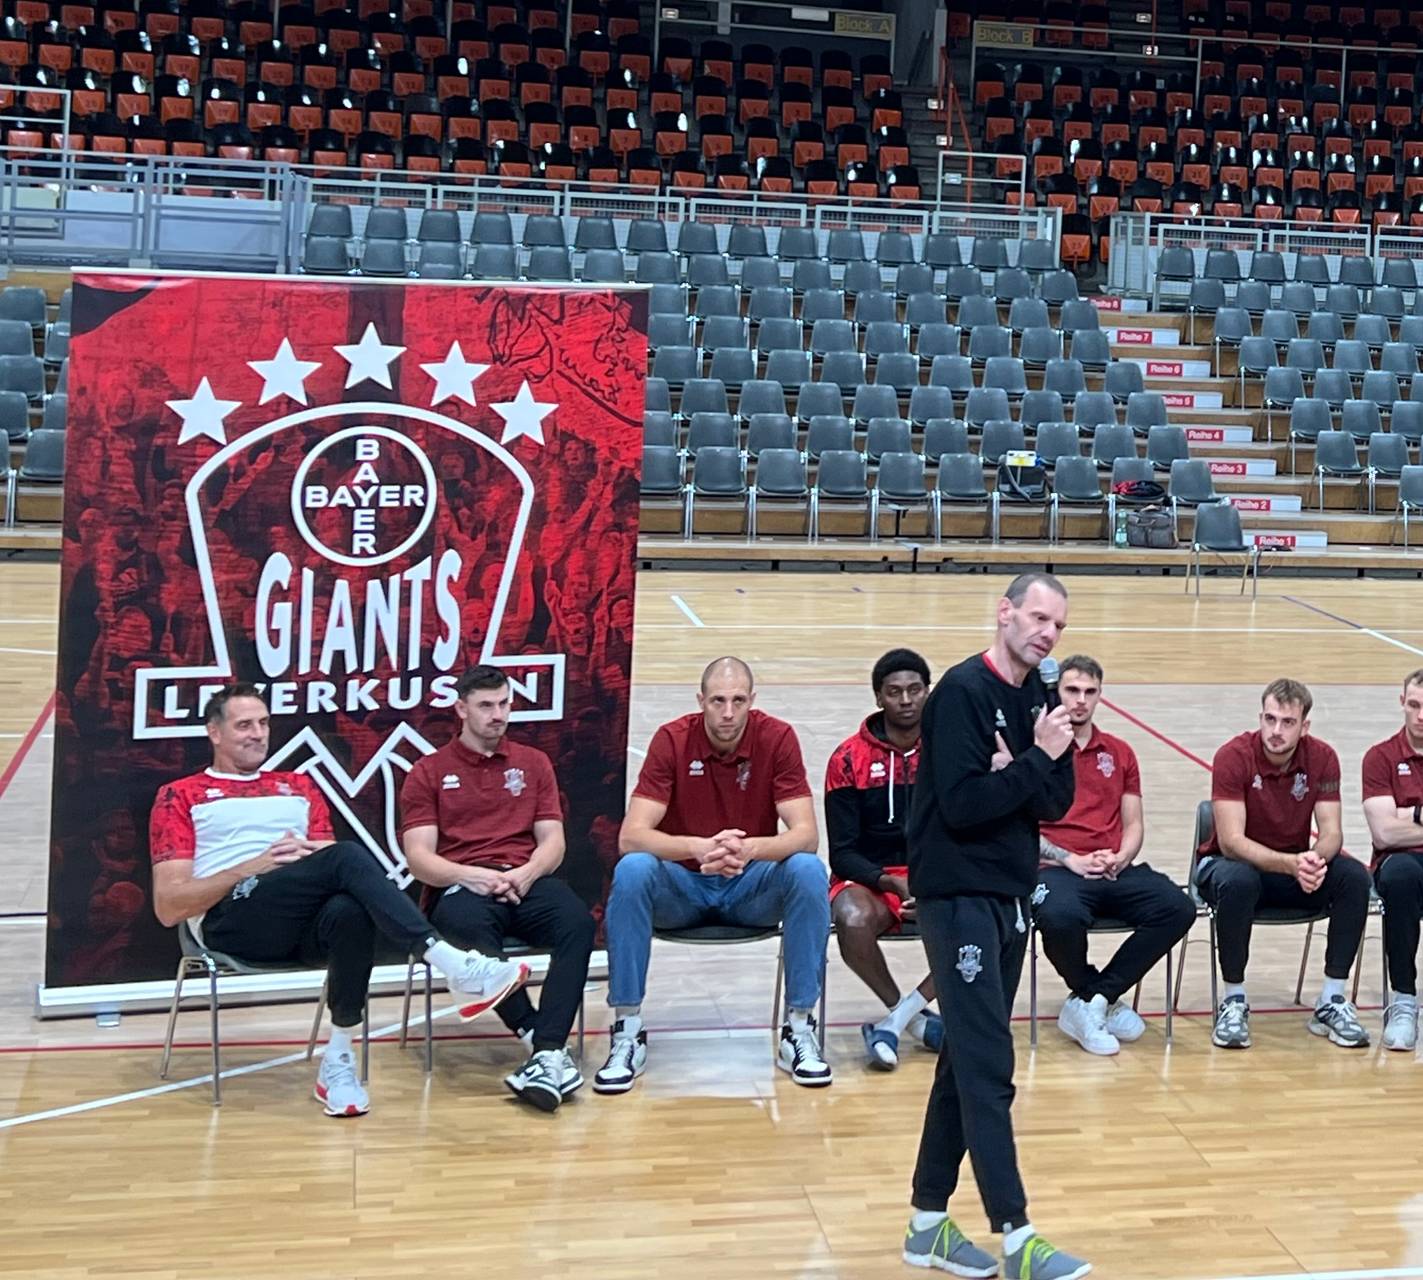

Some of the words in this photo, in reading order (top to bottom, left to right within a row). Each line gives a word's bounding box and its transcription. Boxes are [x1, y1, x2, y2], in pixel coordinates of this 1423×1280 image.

[837, 15, 872, 32] Block
[879, 20, 891, 33] A
[977, 28, 1013, 42] Block
[1022, 31, 1034, 43] B
[1120, 332, 1142, 341] Reihe
[1150, 364, 1173, 373] Reihe
[1188, 430, 1212, 439] Reihe
[1213, 431, 1220, 439] 4
[1211, 463, 1235, 473] Reihe
[1236, 464, 1243, 473] 3
[305, 485, 425, 508] BAYER
[352, 438, 380, 555] BAYER
[1234, 500, 1259, 509] Reihe
[1260, 501, 1267, 509] 2
[1259, 537, 1285, 545] Reihe
[255, 548, 463, 678] GIANTS
[165, 671, 538, 719] LEERKUSN
